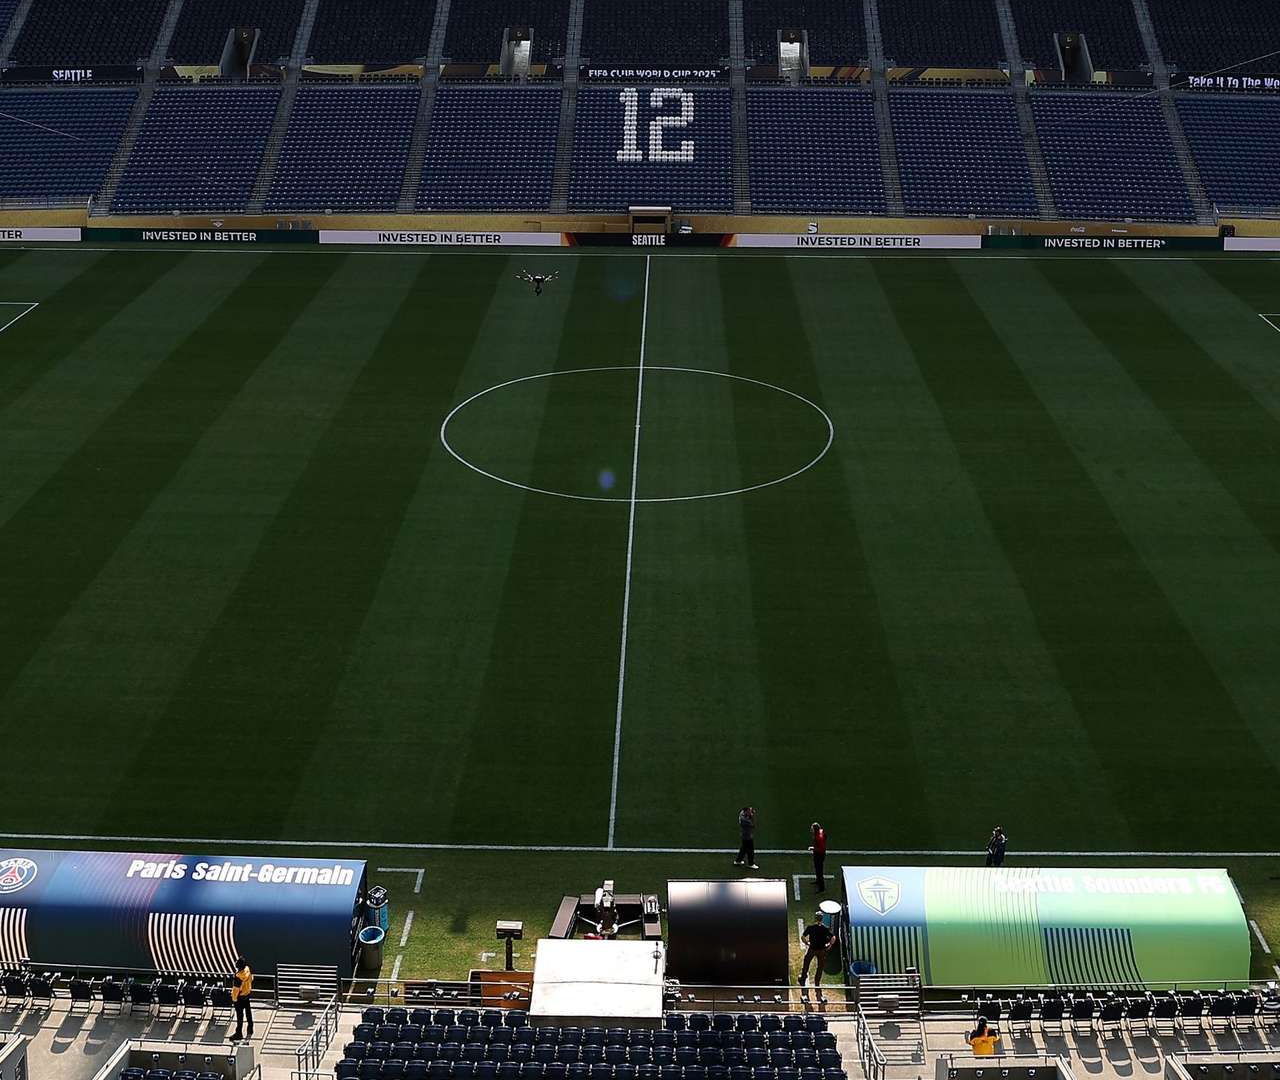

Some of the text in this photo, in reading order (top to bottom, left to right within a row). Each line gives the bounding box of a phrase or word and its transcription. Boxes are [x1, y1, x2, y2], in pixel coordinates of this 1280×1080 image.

[52, 69, 93, 81] SEATTLE
[588, 70, 607, 78] FIFA
[1188, 76, 1213, 88] Take
[1217, 77, 1224, 88] It
[1242, 77, 1261, 88] The
[617, 87, 694, 162] 12
[142, 231, 257, 242] INVESTED IN BETTER
[378, 233, 501, 244] INVESTED IN BETTER
[631, 234, 666, 246] SEATTLE
[797, 236, 921, 247] INVESTED IN BETTER
[1044, 238, 1161, 249] INVESTED IN BETTER
[127, 860, 354, 885] Paris Saint-Germain
